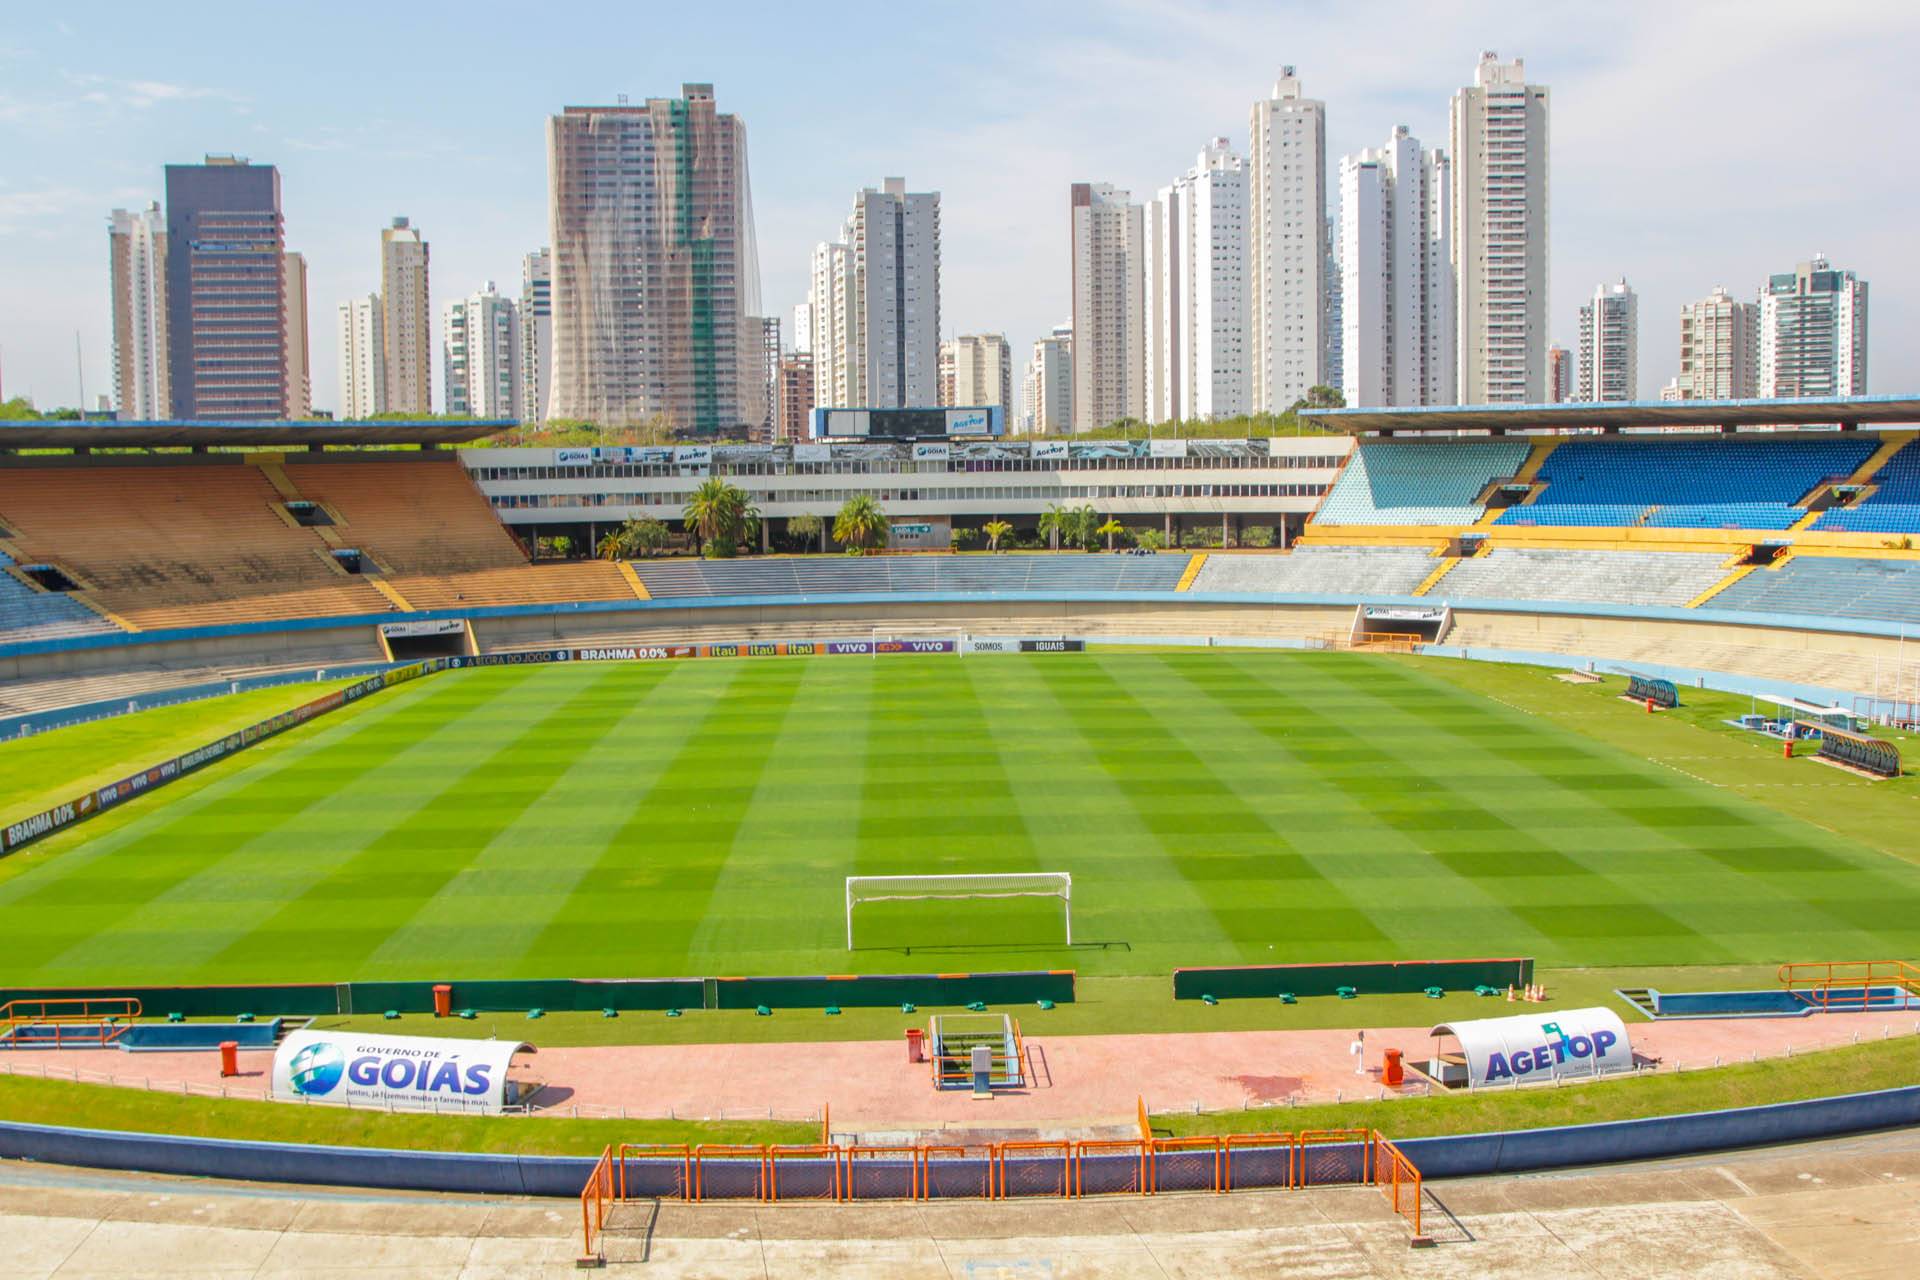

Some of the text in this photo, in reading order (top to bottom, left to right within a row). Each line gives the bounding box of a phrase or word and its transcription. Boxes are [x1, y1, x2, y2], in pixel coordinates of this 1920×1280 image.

[974, 642, 1003, 651] SOMOS
[1035, 642, 1065, 651] IGUAIS
[467, 653, 552, 667] A REGRA DO JOGO
[580, 649, 636, 660] BRAHMA
[8, 812, 53, 846] BRAHMA
[356, 1045, 441, 1059] GOVERNO DE
[1485, 1028, 1617, 1083] AGETOP
[348, 1055, 492, 1096] GOIÁS
